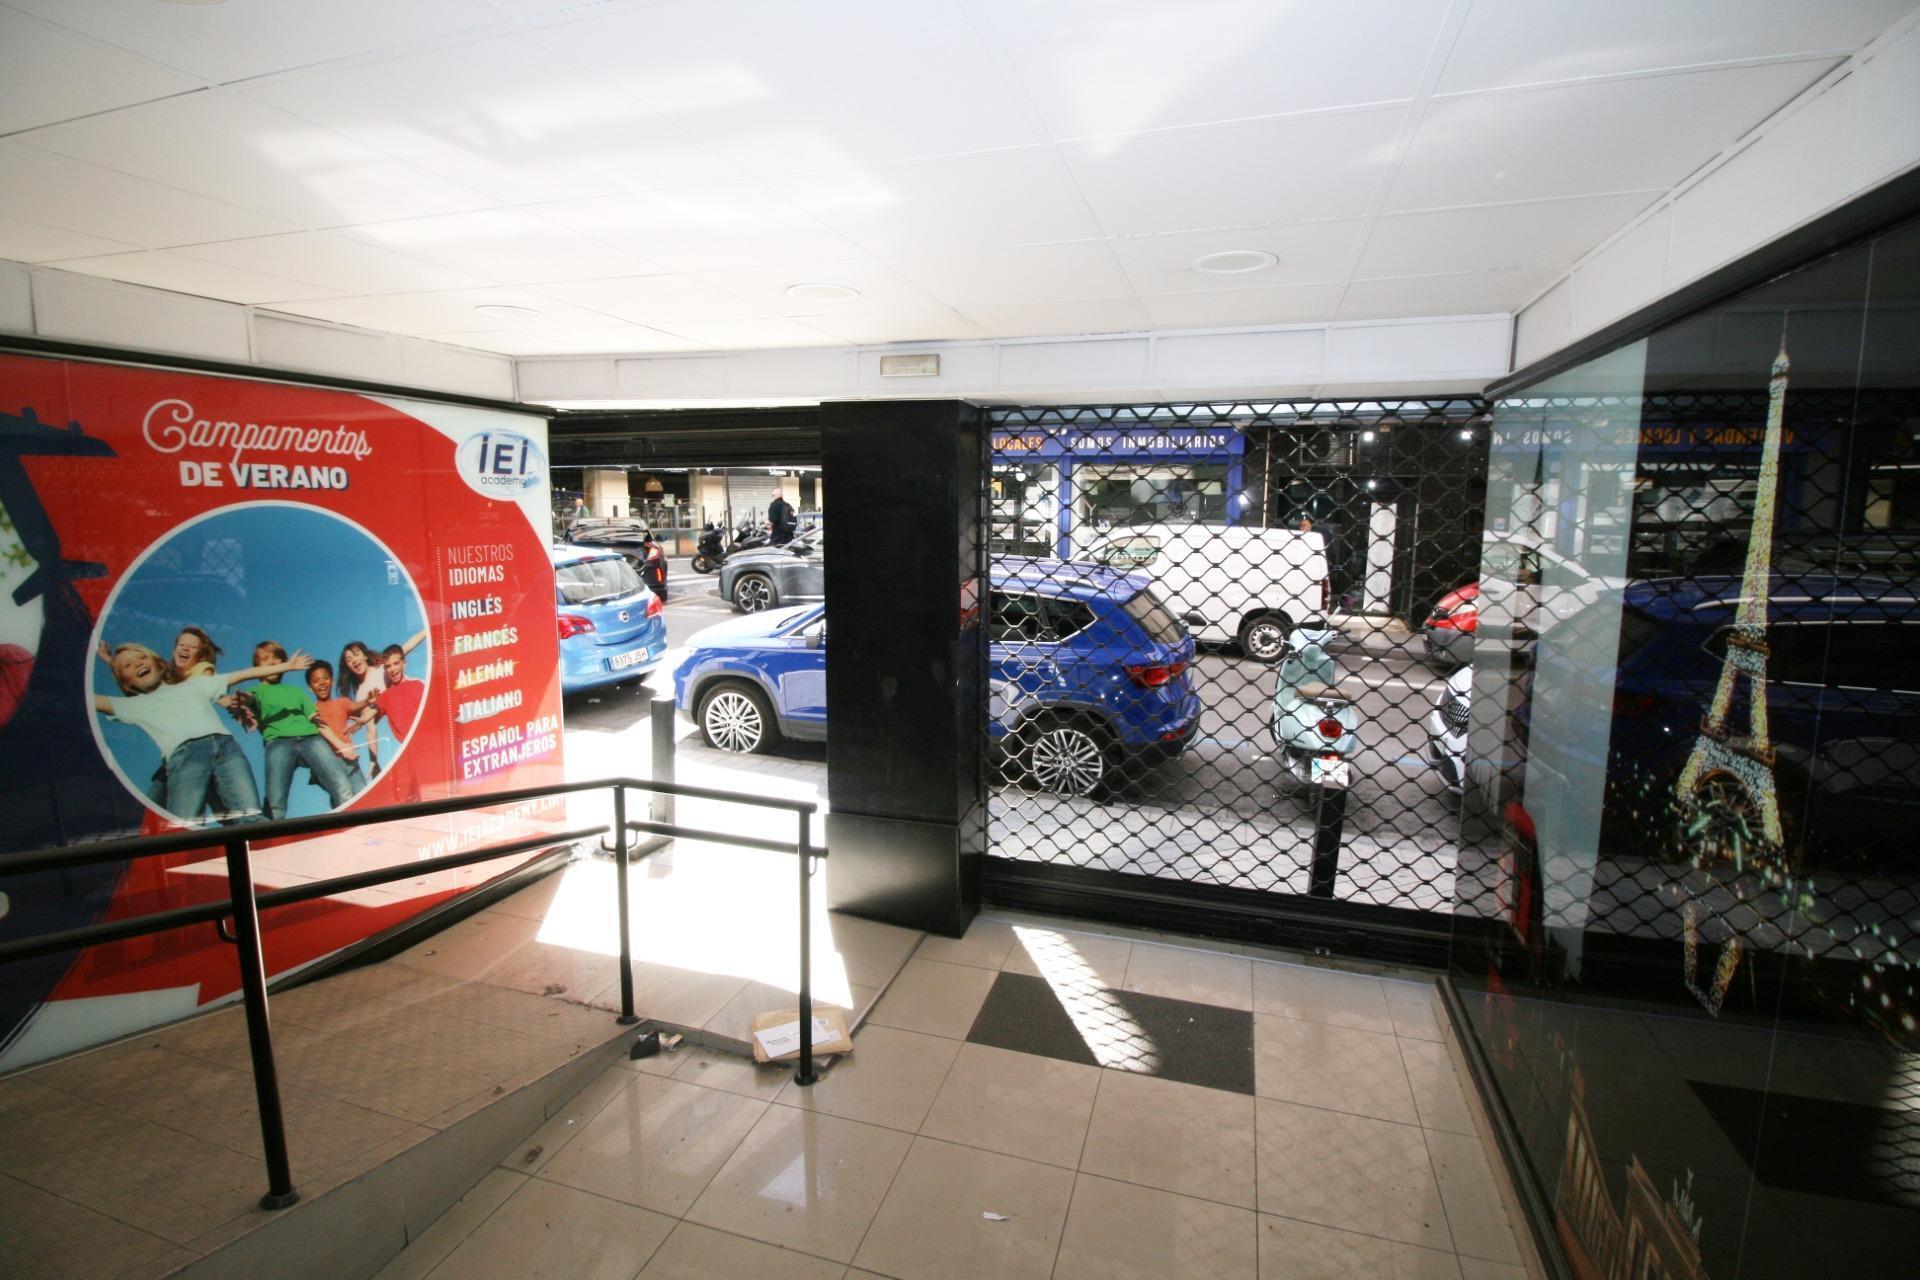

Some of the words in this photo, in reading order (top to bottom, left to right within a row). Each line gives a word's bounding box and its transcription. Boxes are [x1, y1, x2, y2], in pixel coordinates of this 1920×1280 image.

[142, 398, 374, 463] Campamentos
[179, 461, 223, 487] DE
[229, 462, 349, 490] VERANO
[480, 475, 527, 488] academy
[447, 544, 514, 564] NUESTROS
[449, 565, 504, 586] IDIOMAS
[452, 593, 503, 620] INGLÉS
[454, 624, 519, 655] FRANCÉS
[457, 658, 514, 687] ALEMÁN
[458, 689, 523, 720] ITALIANO
[462, 725, 523, 759] ESPAÑOL
[526, 714, 559, 738] PARA
[463, 734, 557, 779] EXTRANJEROS
